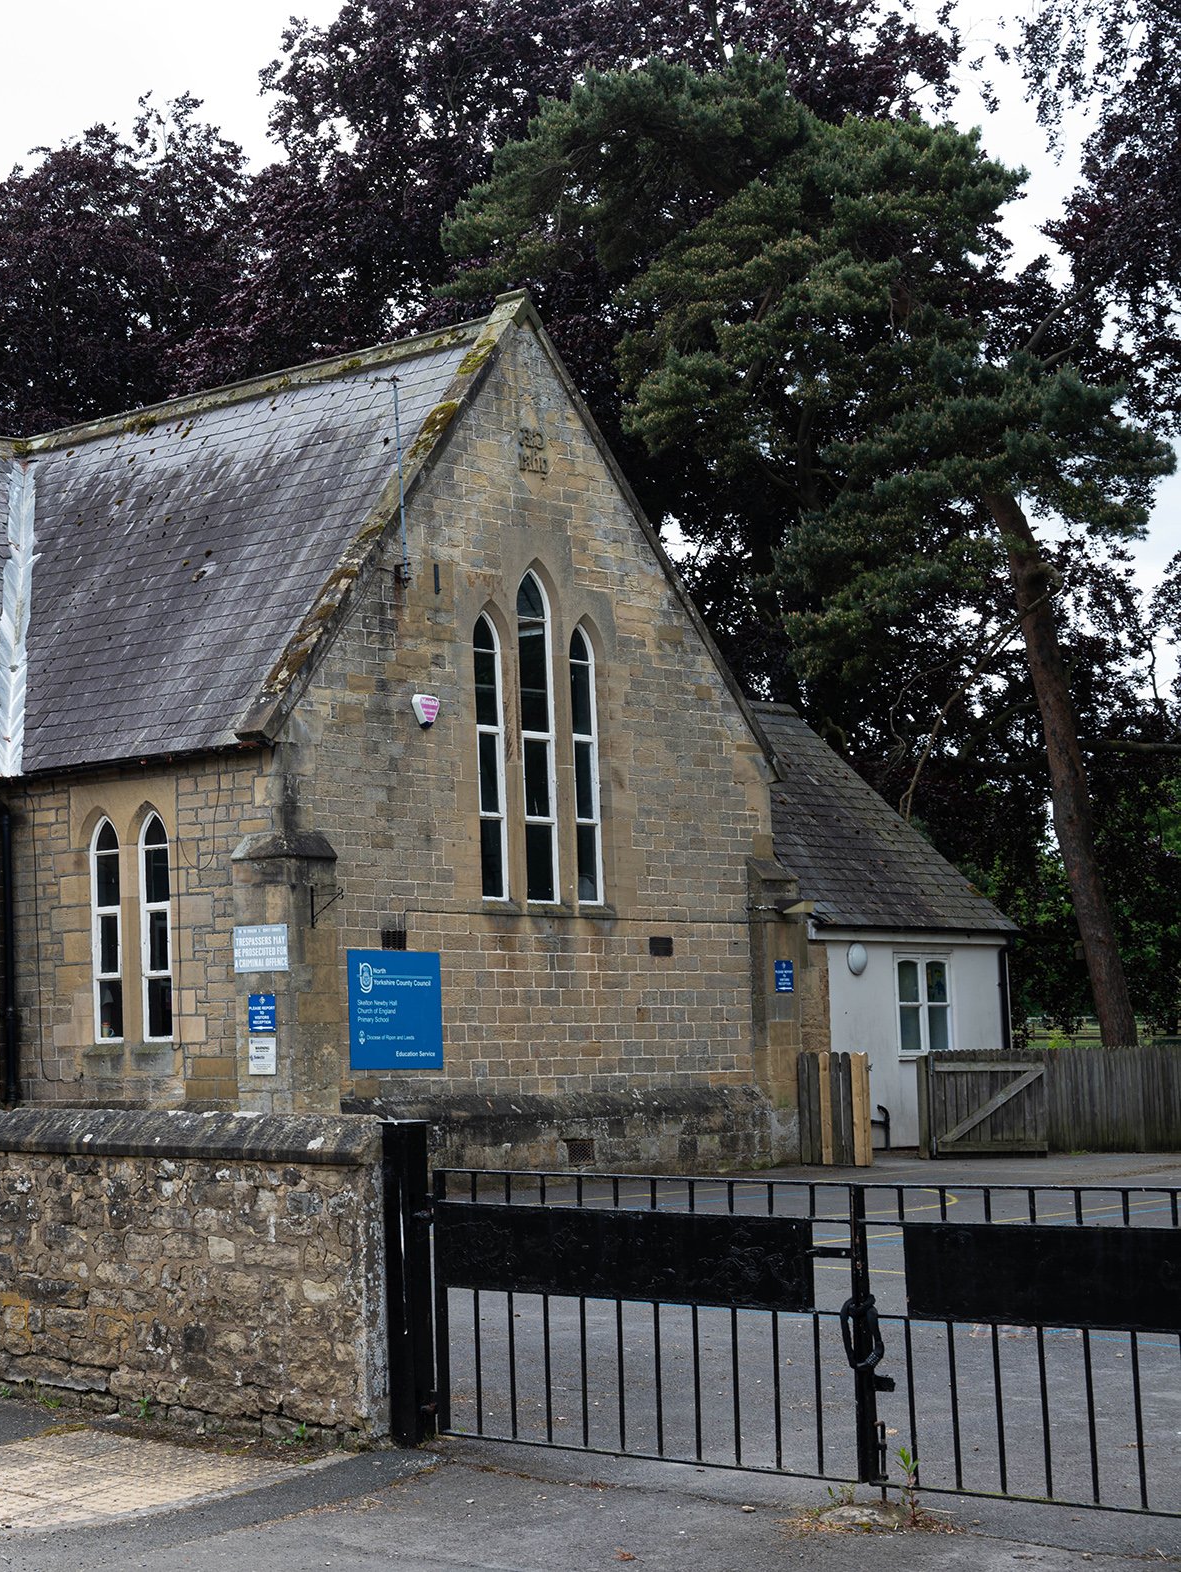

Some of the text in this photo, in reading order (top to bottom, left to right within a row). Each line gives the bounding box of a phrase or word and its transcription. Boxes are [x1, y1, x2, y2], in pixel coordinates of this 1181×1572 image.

[236, 935, 286, 946] TRESPASSERS MAY
[235, 945, 287, 957] BE PROSECUTED FOR
[235, 957, 287, 968] A CRIMINAL OFFENCE
[373, 1000, 389, 1008] Newby
